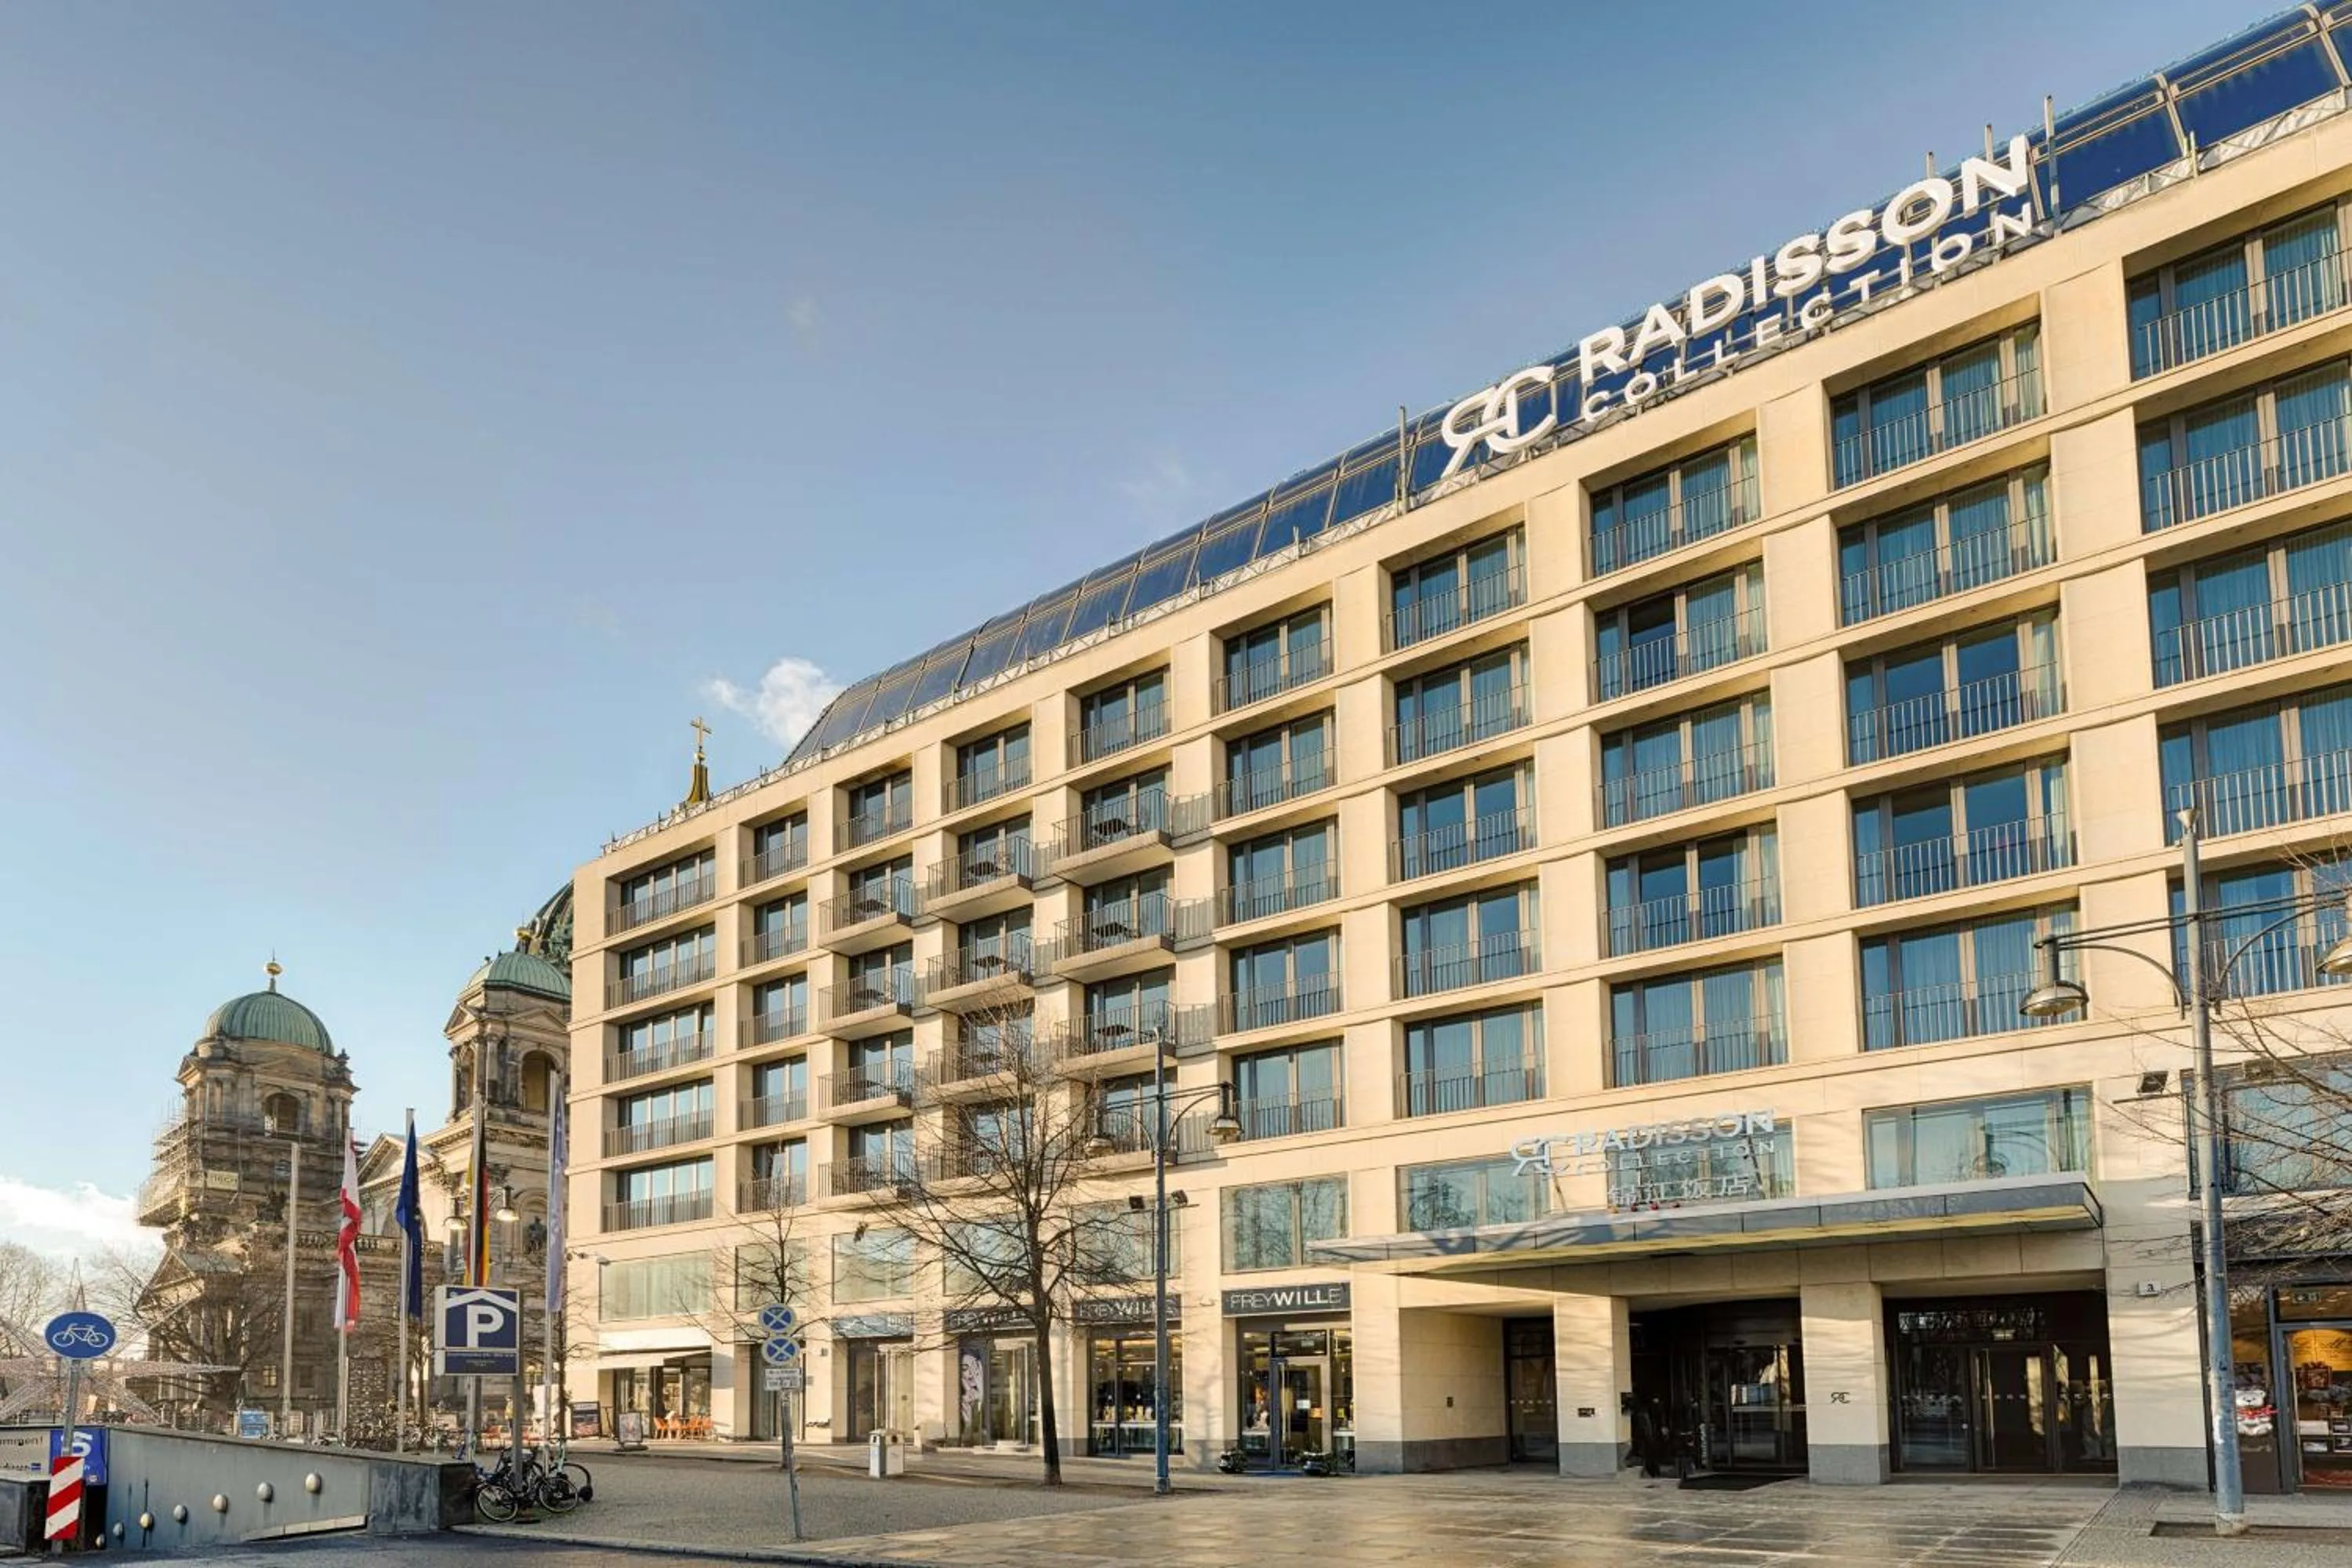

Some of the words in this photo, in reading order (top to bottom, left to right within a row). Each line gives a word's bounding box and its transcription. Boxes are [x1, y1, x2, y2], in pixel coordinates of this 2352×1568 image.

[1578, 133, 2031, 387] RADISSON
[1582, 201, 2034, 424] COLLECTION
[1575, 1109, 1774, 1156] RADISSON
[1229, 1288, 1343, 1310] FREYWILLE
[466, 1304, 504, 1348] P
